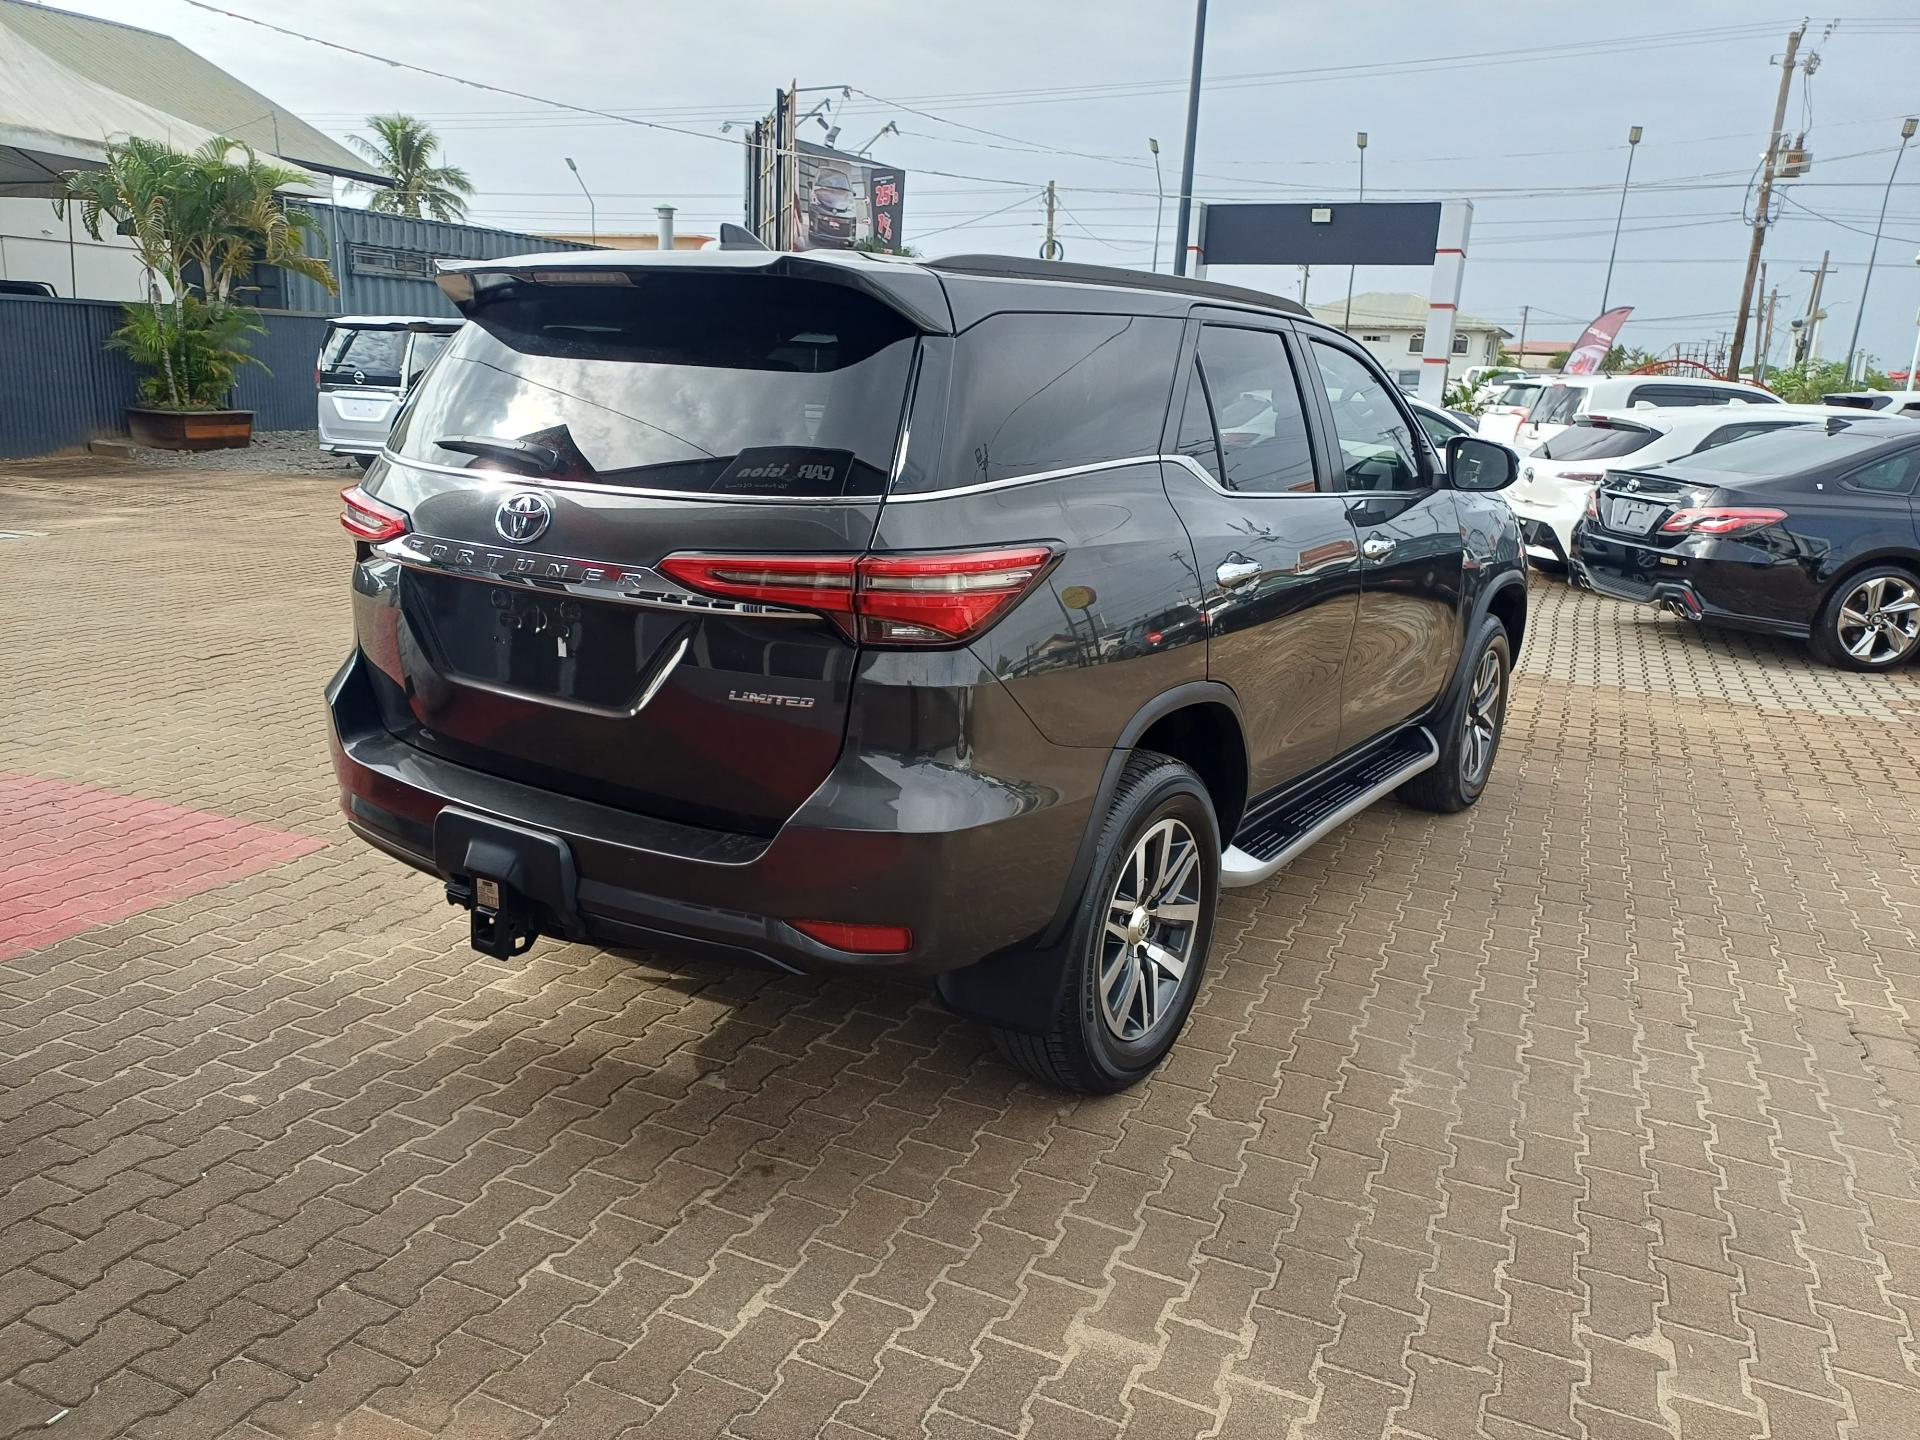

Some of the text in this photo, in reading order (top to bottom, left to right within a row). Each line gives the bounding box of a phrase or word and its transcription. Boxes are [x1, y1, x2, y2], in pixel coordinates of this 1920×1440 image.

[875, 183, 899, 206] 25%
[407, 539, 640, 588] FORTUNER
[728, 690, 815, 707] LIMITED
